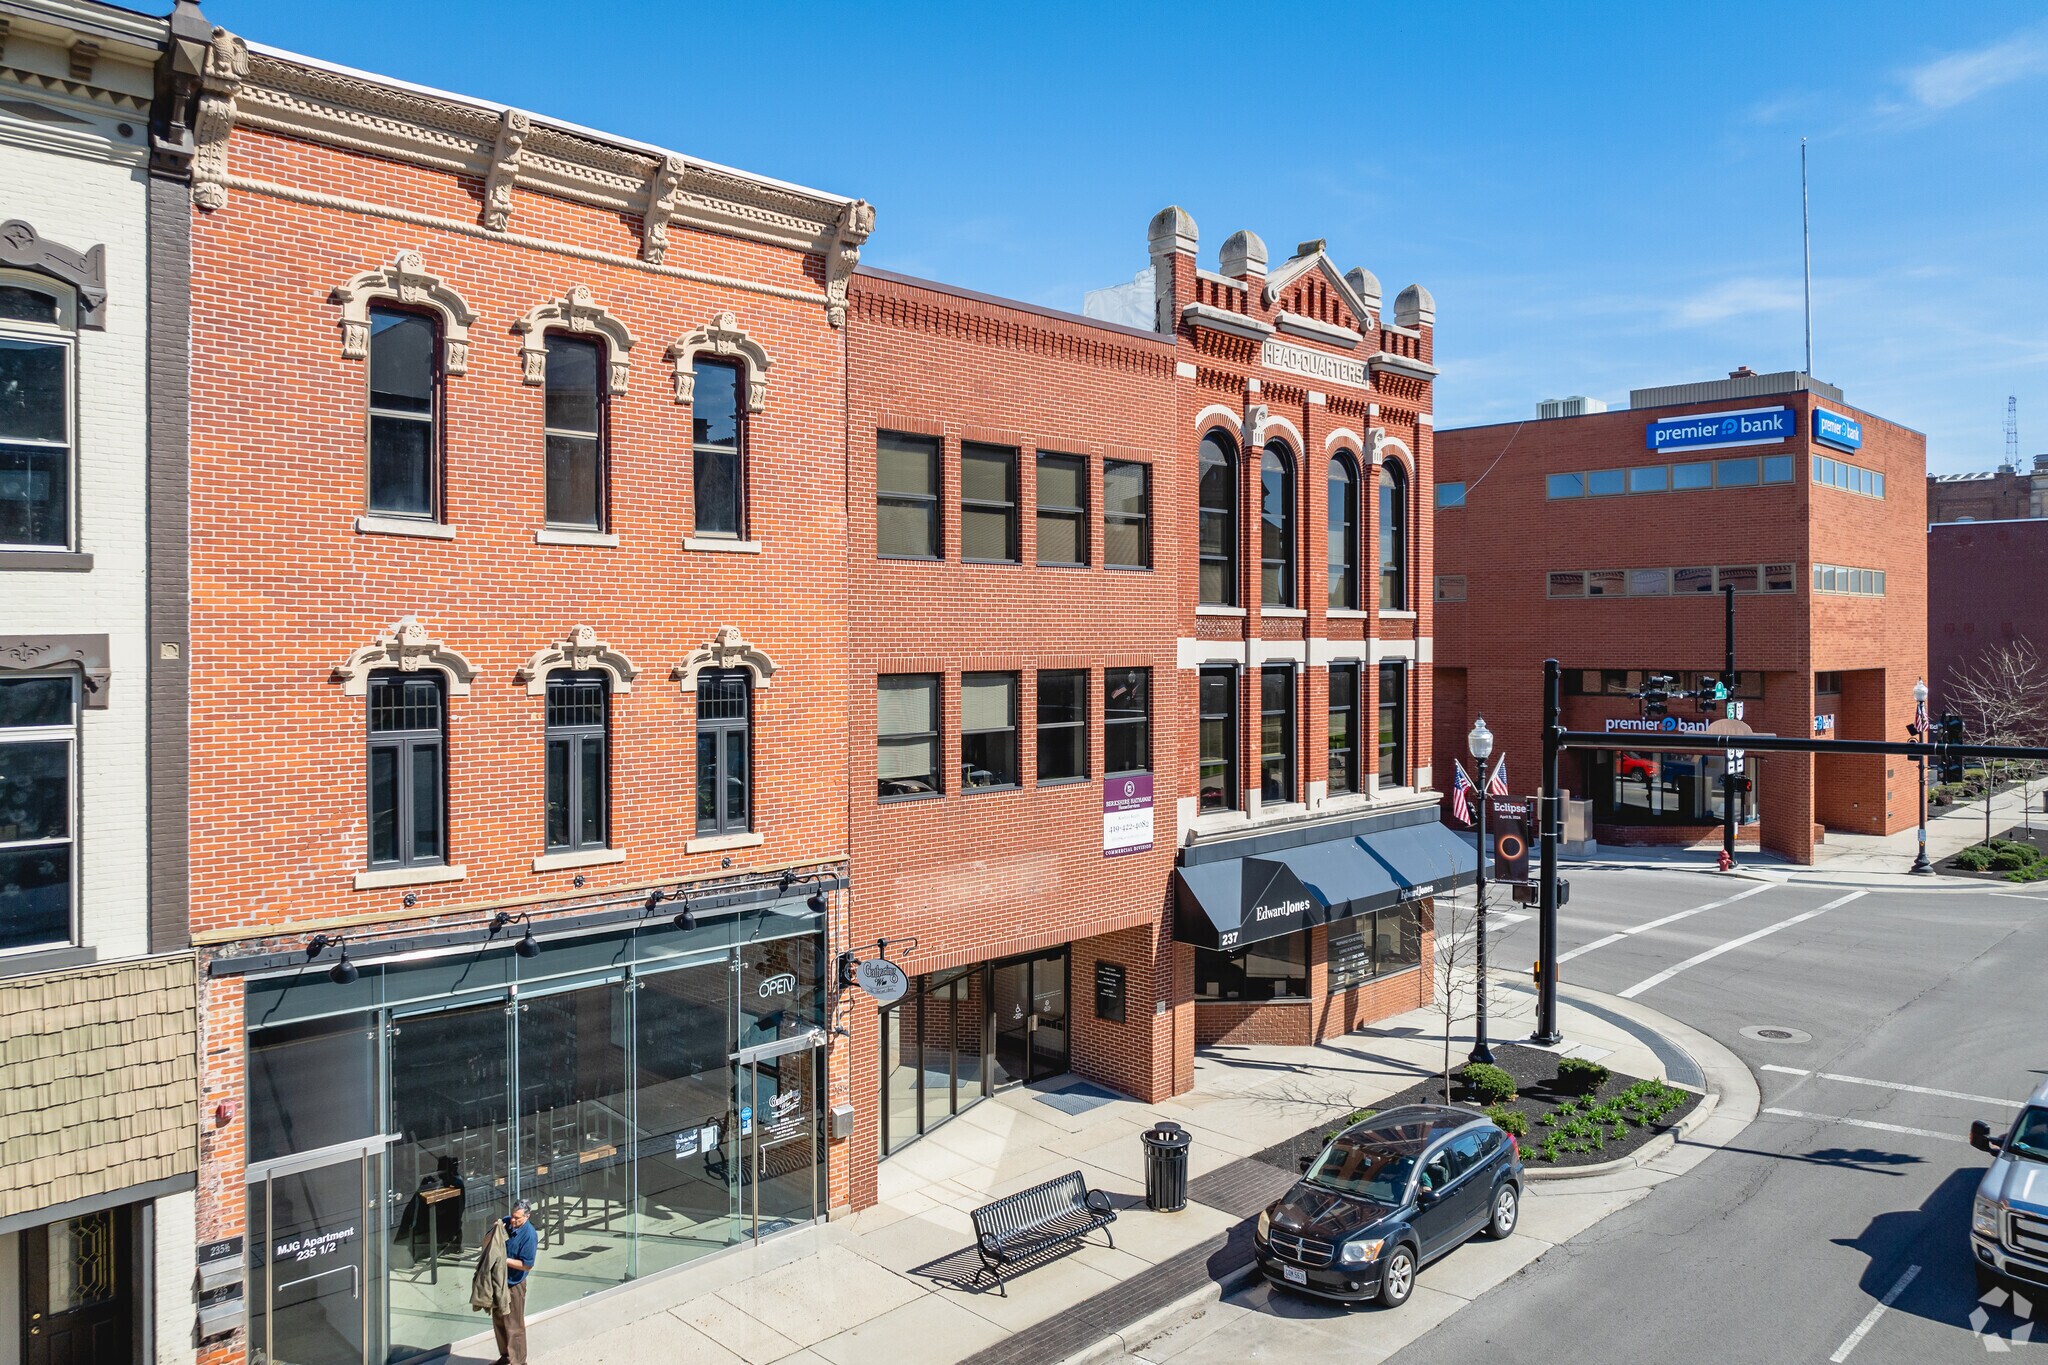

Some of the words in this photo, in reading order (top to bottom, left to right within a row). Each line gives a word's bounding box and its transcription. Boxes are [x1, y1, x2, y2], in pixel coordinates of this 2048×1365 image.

[1655, 422, 1719, 445] premier
[1740, 414, 1783, 433] bank
[1821, 417, 1842, 434] premier
[1847, 425, 1860, 441] bank
[1605, 717, 1660, 732] premier
[1105, 799, 1130, 807] BERKSHIRE
[1493, 802, 1527, 814] Eclipse
[1105, 847, 1133, 856] COMMERCIAL
[1133, 843, 1152, 852] DIVISION
[1221, 931, 1239, 946] 237
[759, 977, 794, 998] OPEN
[276, 1240, 300, 1256] MJG
[304, 1226, 354, 1249] Apartment
[296, 1247, 317, 1262] 235
[320, 1242, 336, 1255] 1/2
